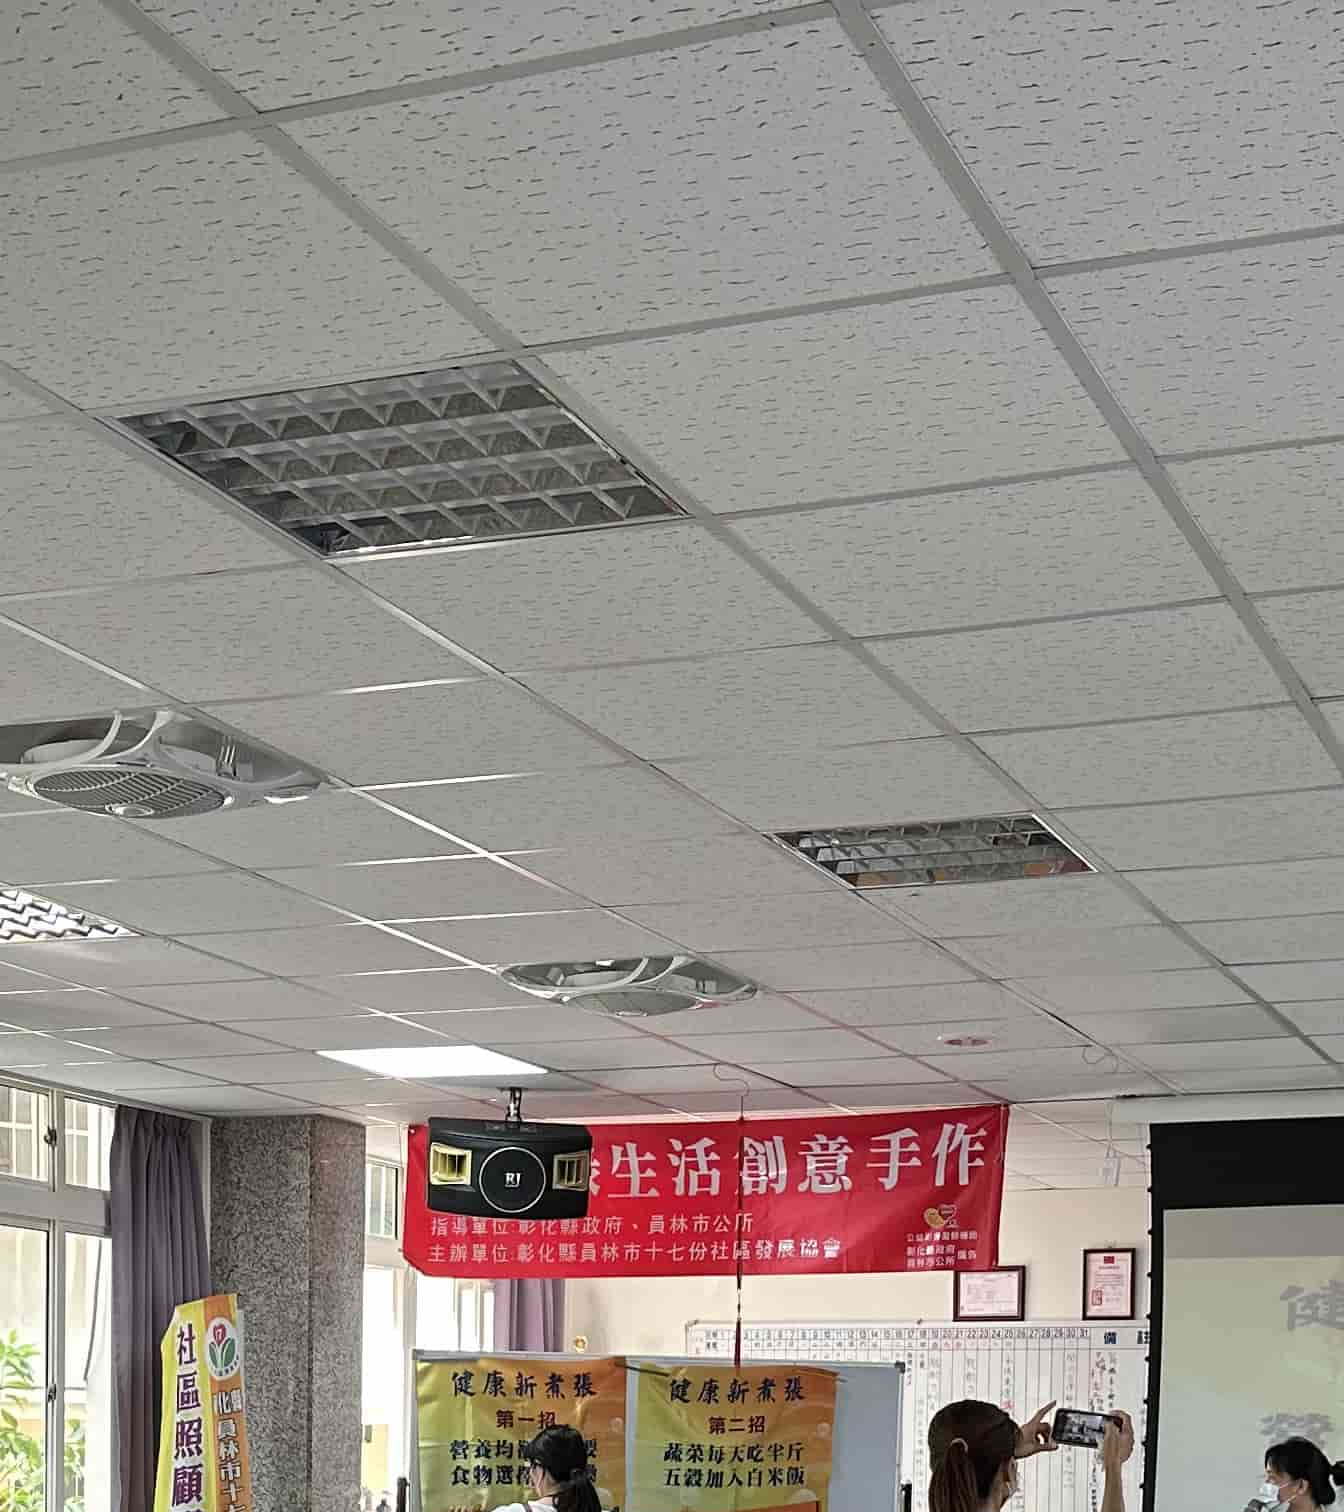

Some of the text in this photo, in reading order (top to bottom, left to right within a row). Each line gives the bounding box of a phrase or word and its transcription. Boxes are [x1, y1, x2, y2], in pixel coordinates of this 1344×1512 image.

[588, 1123, 988, 1198] 生活創意手作
[452, 1371, 597, 1399] 健康新煮張
[669, 1375, 807, 1405] 健康新煮張
[496, 1409, 557, 1430] 第一招
[708, 1416, 766, 1435] 第二招
[663, 1441, 805, 1465] 蔬菜每天吃半斤
[664, 1465, 805, 1489] 五穀加入白米飯
